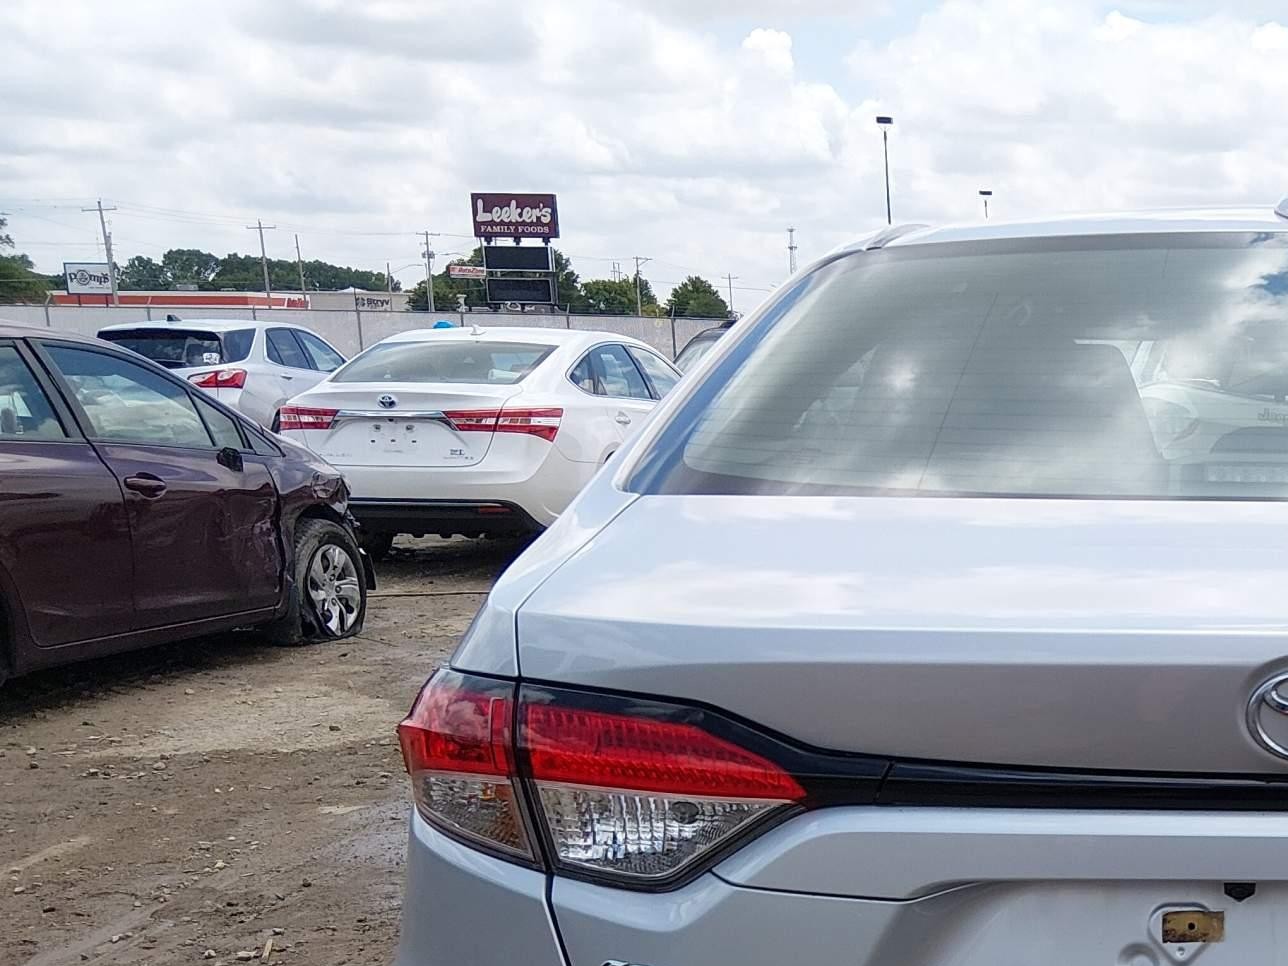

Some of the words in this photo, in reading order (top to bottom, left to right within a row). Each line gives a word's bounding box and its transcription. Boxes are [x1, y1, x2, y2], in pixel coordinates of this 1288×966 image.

[475, 198, 552, 223] Leeker's
[480, 225, 516, 233] FAMILY
[518, 225, 550, 233] FOODS
